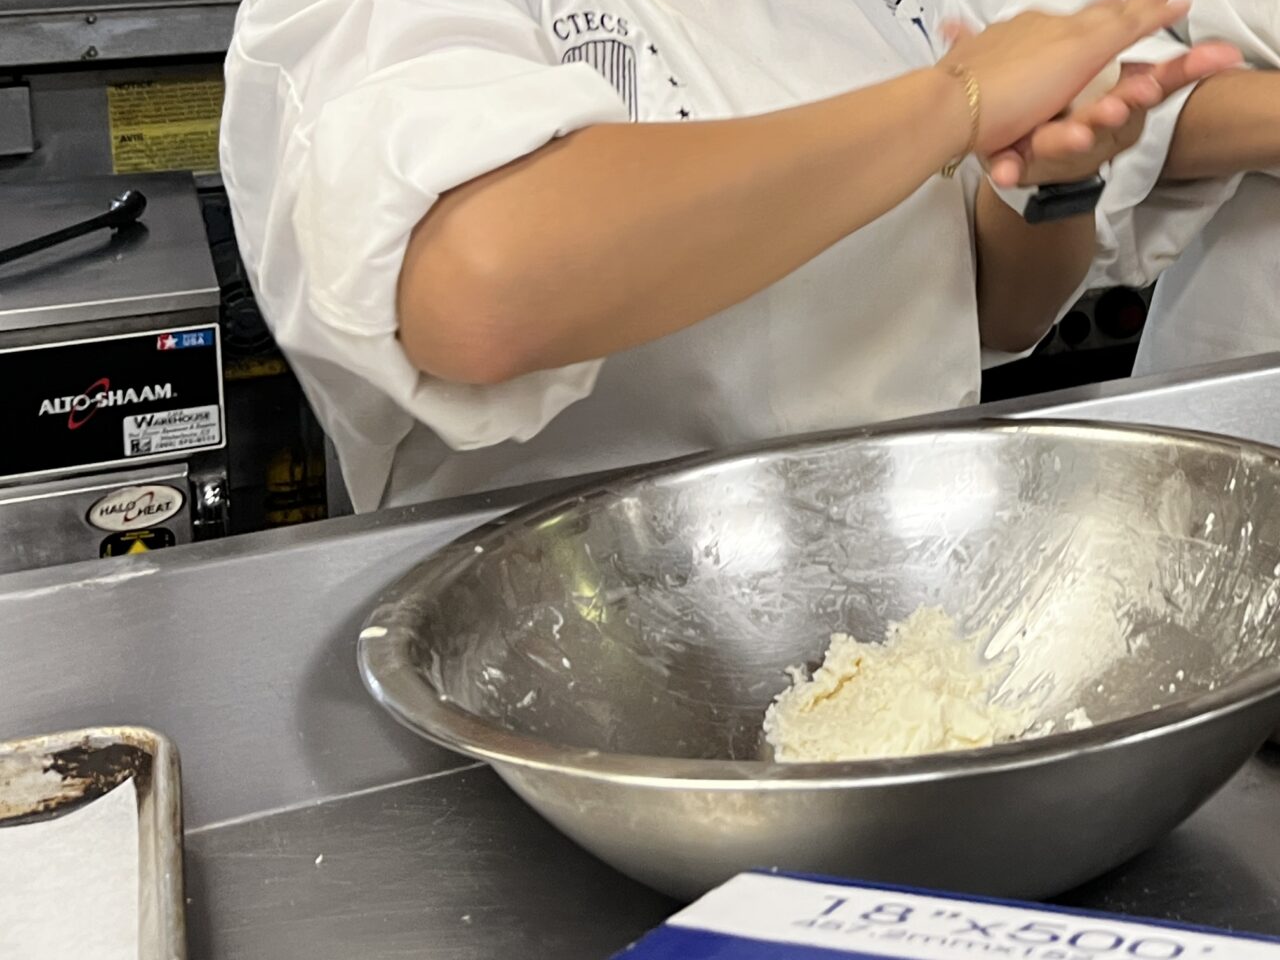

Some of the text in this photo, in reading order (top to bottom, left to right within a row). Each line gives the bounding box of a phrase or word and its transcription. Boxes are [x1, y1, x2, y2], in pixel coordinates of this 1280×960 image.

[553, 11, 628, 40] CTECS
[39, 382, 172, 416] ALTO-SHAAM
[100, 501, 172, 517] HALO HEAT
